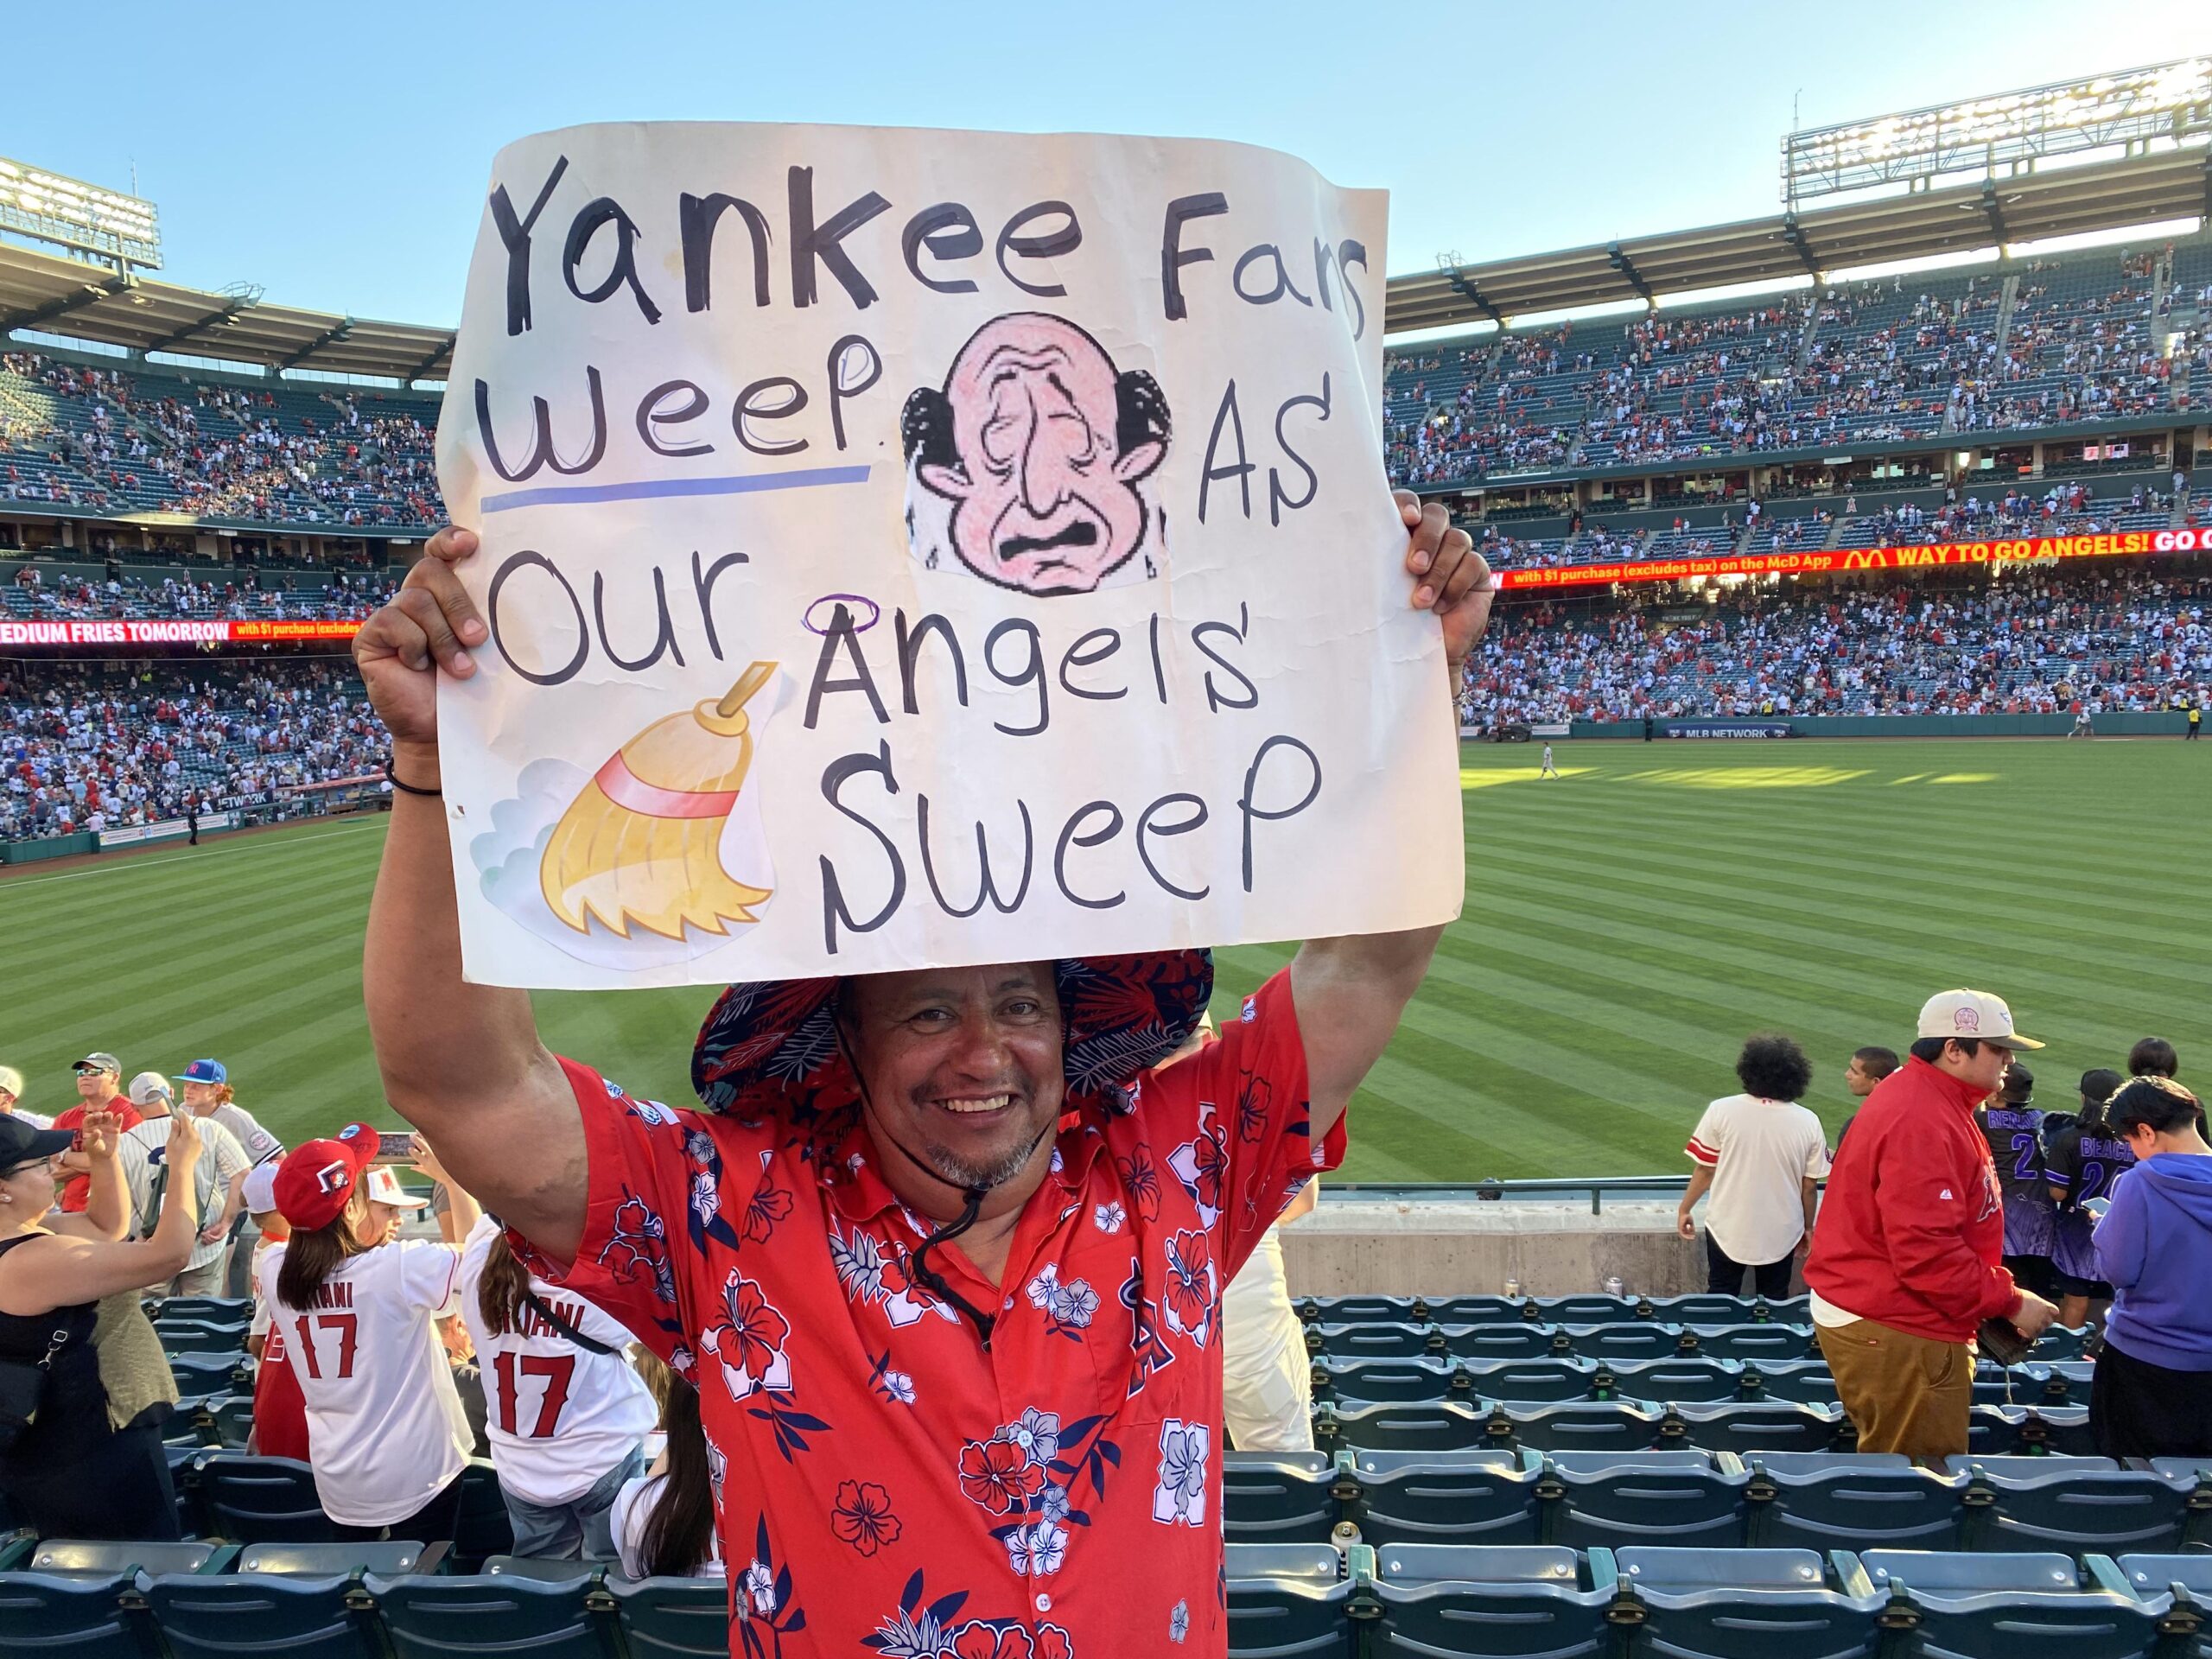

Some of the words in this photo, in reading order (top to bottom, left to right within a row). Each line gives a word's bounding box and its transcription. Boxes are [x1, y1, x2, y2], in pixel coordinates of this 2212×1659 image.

[490, 155, 1082, 336] Yankee
[1897, 546, 1950, 566] WAY
[1955, 543, 1989, 563] TO
[1994, 541, 2031, 559] GO
[2037, 533, 2149, 557] ANGELS!
[2155, 531, 2196, 551] GO
[1514, 571, 1541, 583] with
[1544, 569, 1558, 582] $1
[1560, 568, 1620, 583] purchase
[1624, 563, 1688, 577] (excludes
[1690, 559, 1717, 573] tax)
[1719, 562, 1738, 571] on
[1740, 558, 1764, 570] the
[1767, 556, 1800, 569] McD
[1803, 555, 1832, 569] App
[71, 622, 126, 643] FRIES
[127, 621, 229, 642] TOMORROW
[237, 622, 259, 635] with
[261, 622, 271, 636] $1
[273, 622, 315, 638] purchase
[488, 550, 749, 685] Our
[804, 596, 1259, 736] Angels
[1687, 728, 1710, 738] MLB
[1712, 728, 1769, 738] NETWORK
[2012, 1134, 2038, 1180] 2
[296, 1313, 358, 1379] 17
[493, 1350, 576, 1439] 17
